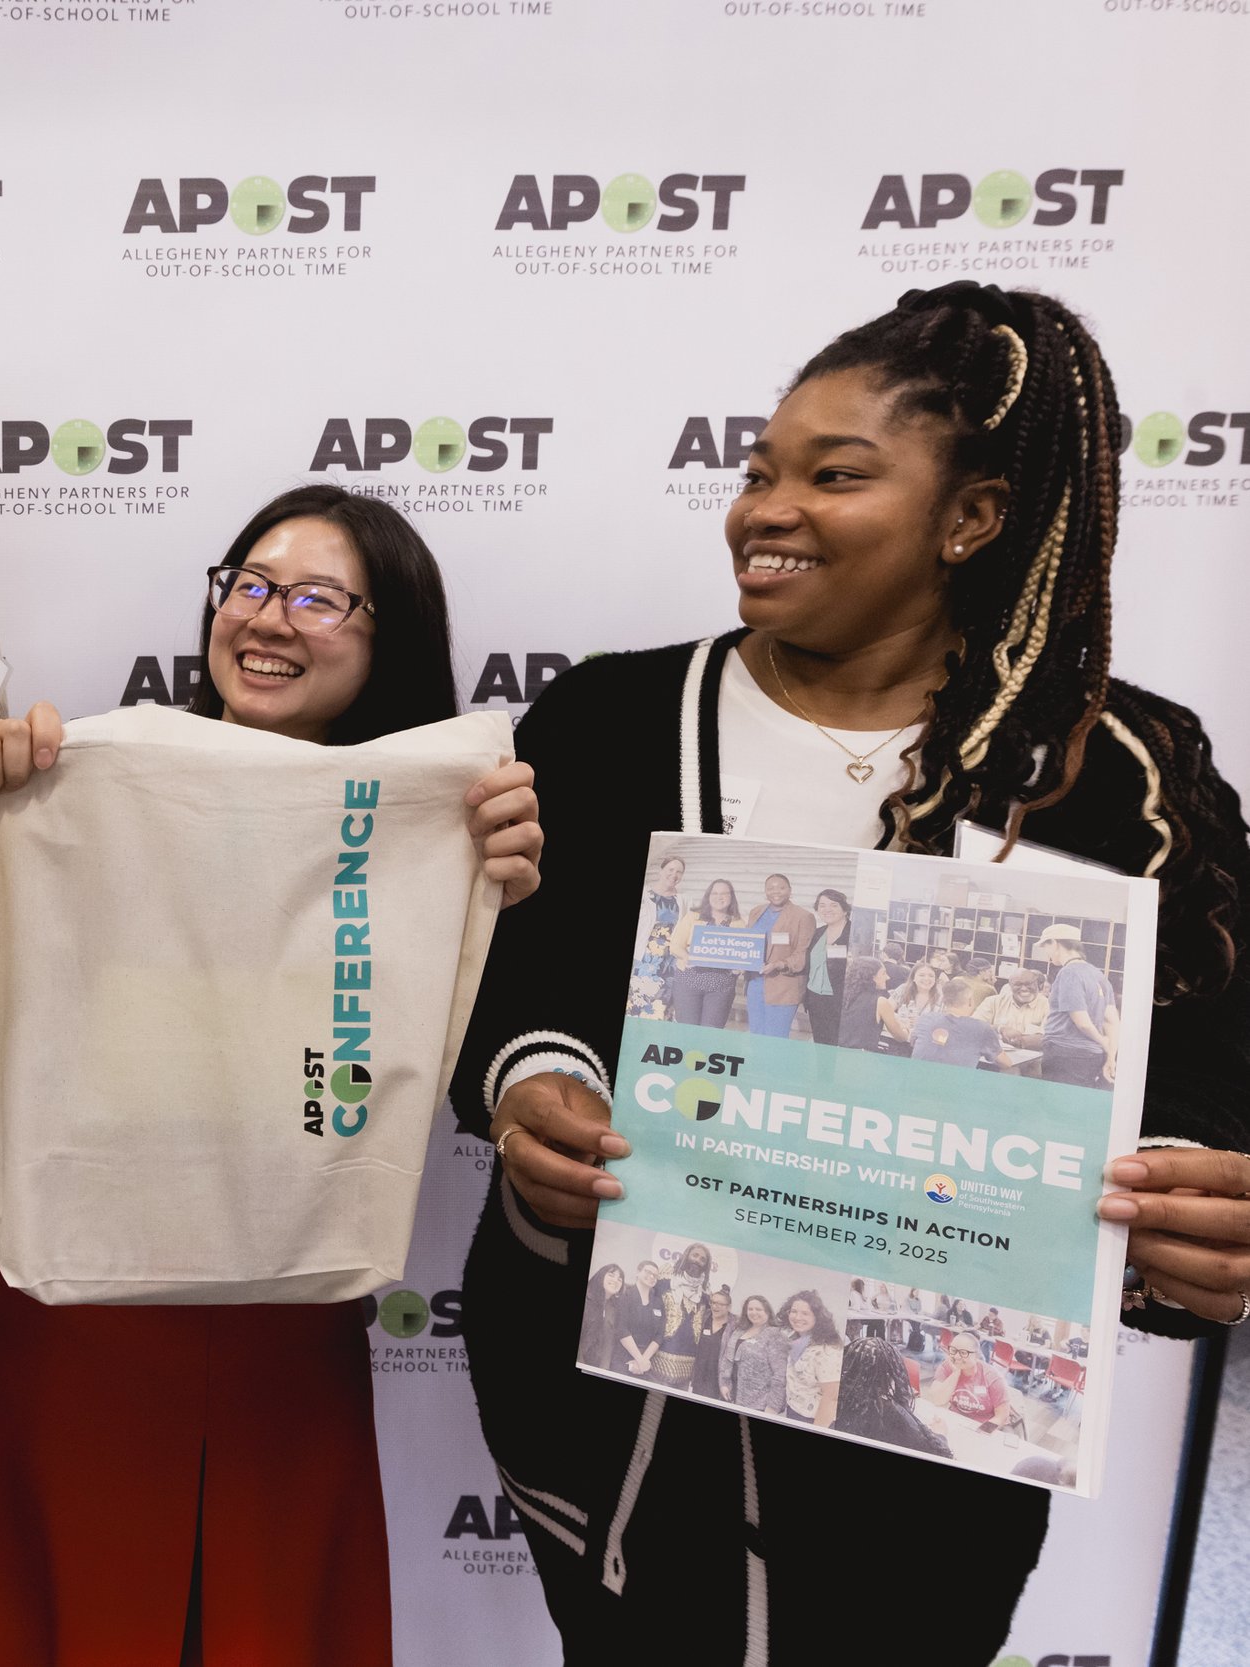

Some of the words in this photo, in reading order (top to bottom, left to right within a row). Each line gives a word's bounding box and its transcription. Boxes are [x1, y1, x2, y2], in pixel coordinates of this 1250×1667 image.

[128, 8, 171, 21] TIME
[345, 3, 500, 19] OUT-OF-SCHOOL
[510, 2, 552, 15] TIME
[724, 1, 876, 17] OUT-OF-SCHOOL
[884, 3, 926, 17] TIME
[122, 175, 376, 237] APOST
[494, 172, 747, 234] APOST
[860, 167, 1126, 230] APOST
[122, 247, 228, 261] ALLEGHENY
[237, 246, 327, 260] PARTNERS
[336, 246, 372, 258] FOR
[492, 245, 598, 258] ALLEGHENY
[606, 245, 695, 258] PARTNERS
[703, 245, 738, 257] FOR
[858, 242, 969, 257] ALLEGHENY
[978, 240, 1073, 254] PARTNERS
[1081, 239, 1115, 252] FOR
[145, 263, 296, 278] OUT-OF-SCHOOL
[304, 263, 347, 275] TIME
[515, 262, 663, 275] OUT-OF-SCHOOL
[671, 262, 713, 274] TIME
[881, 258, 1039, 272] OUT-OF-SCHOOL
[1048, 255, 1090, 269] TIME
[309, 415, 554, 474] APOST
[60, 487, 147, 499] PARTNERS
[156, 486, 190, 498] FOR
[419, 484, 505, 497] PARTNERS
[514, 484, 548, 496] FOR
[666, 483, 743, 495] ALLEGHE
[1136, 479, 1220, 492] PARTNERS
[1229, 479, 1250, 491] FO
[125, 503, 166, 514] TIME
[482, 500, 523, 511] TIME
[1196, 495, 1239, 507] TIME
[701, 936, 727, 946] Let's
[727, 938, 755, 949] Keep
[330, 780, 381, 1138] CONFERENCE
[693, 946, 748, 959] BOOSTing
[641, 1044, 745, 1077] APOST
[304, 1047, 325, 1137] APOST
[634, 1072, 1085, 1191] CONFERENCE
[675, 1132, 696, 1149] IN
[703, 1137, 851, 1176] PARTNERSHIP
[858, 1165, 917, 1192] WITH
[960, 1179, 997, 1197] UNITED
[1000, 1186, 1023, 1202] WAY
[958, 1200, 1012, 1217] Pennsylvania
[969, 1194, 1026, 1212] Southwestern
[685, 1173, 724, 1193] OST
[729, 1182, 889, 1226] PARTNERSHIPS
[896, 1214, 919, 1232] IN
[925, 1222, 1011, 1252] ACTION
[734, 1208, 857, 1246] SEPTEMBER
[863, 1234, 892, 1256] 29,
[899, 1241, 949, 1265] 2025
[443, 1549, 528, 1562] ALLEGHEN
